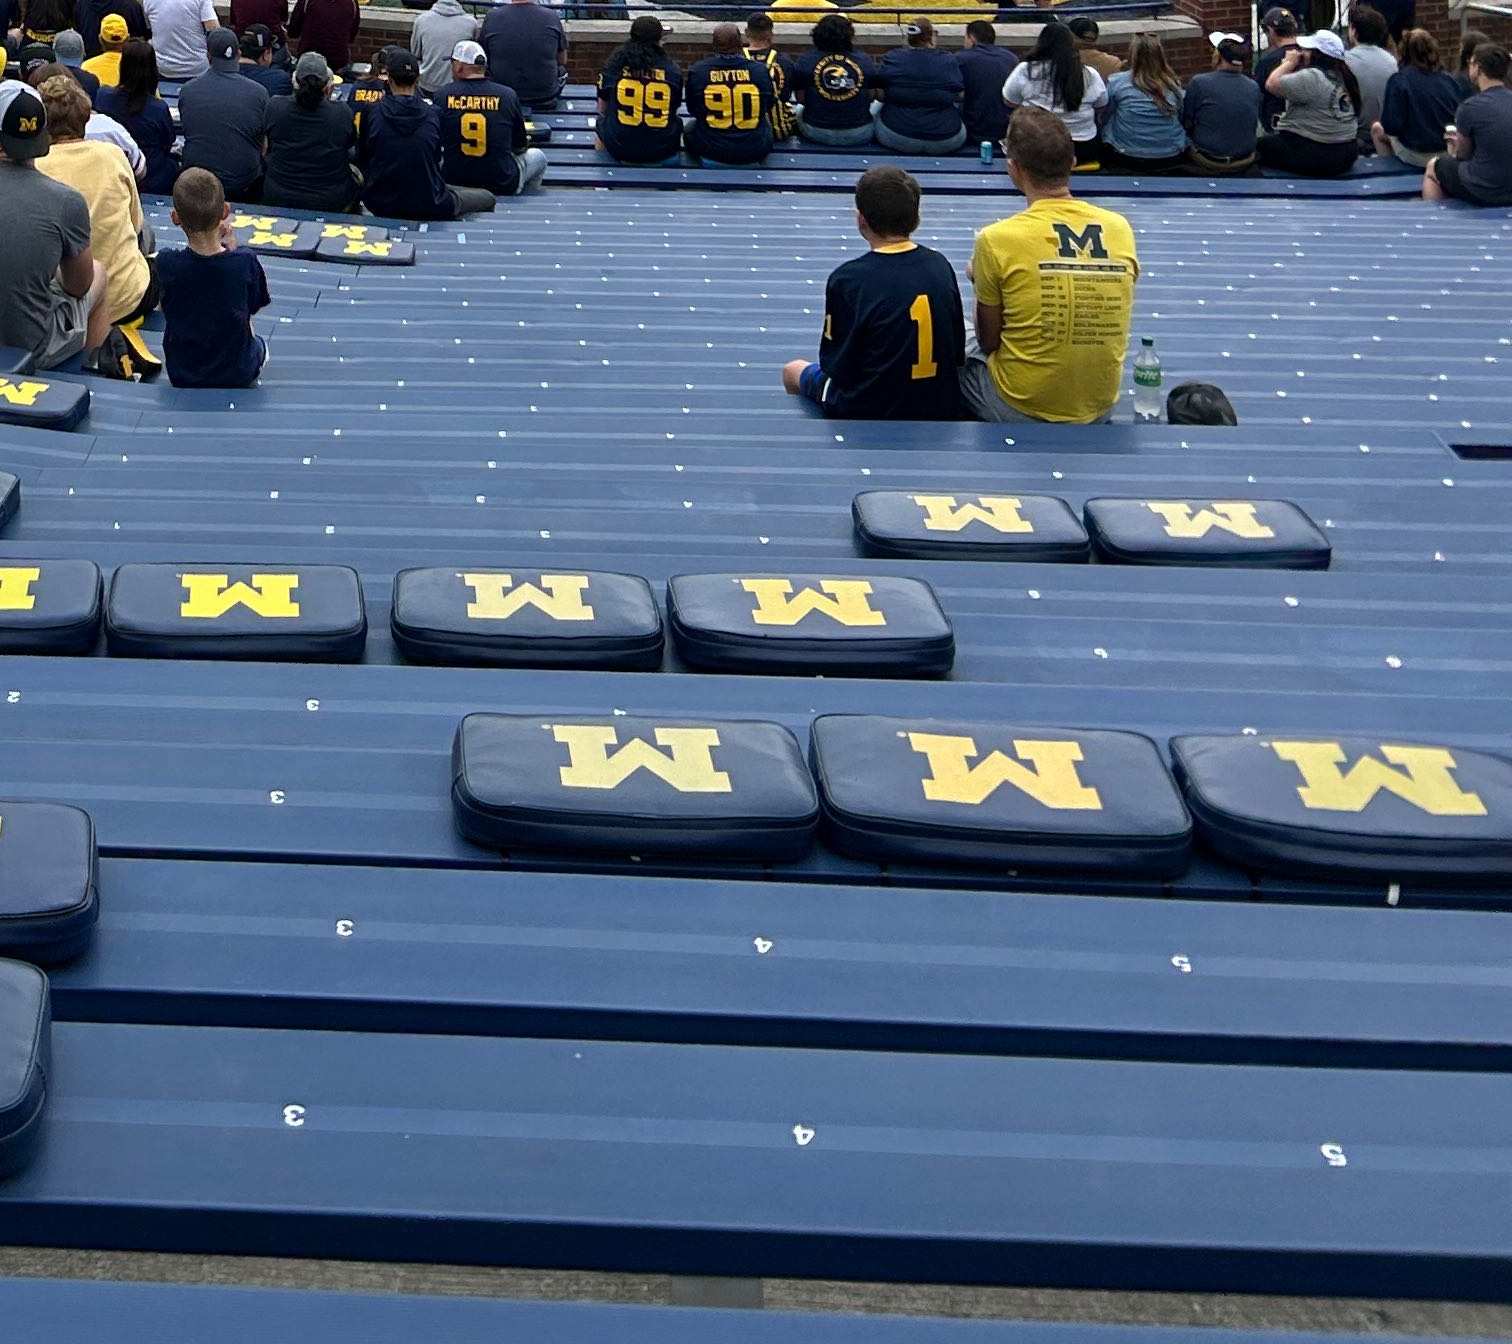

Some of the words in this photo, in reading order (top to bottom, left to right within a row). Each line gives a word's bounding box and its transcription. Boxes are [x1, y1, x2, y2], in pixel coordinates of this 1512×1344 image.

[710, 69, 750, 83] GUYTON
[447, 95, 500, 111] McCARTHY
[617, 78, 672, 129] 99
[703, 83, 761, 130] 90
[18, 116, 38, 132] M
[460, 112, 487, 158] 9
[248, 230, 298, 247] M
[344, 239, 392, 255] M
[1052, 223, 1109, 259] M
[909, 294, 938, 380] 1
[916, 496, 1032, 531] M
[1152, 503, 1271, 536] M
[181, 574, 300, 618] M
[465, 574, 593, 619] M
[743, 579, 885, 625] M
[7, 691, 21, 703] 2
[306, 699, 320, 711] 3
[553, 726, 730, 790] M
[908, 733, 1101, 809] M
[1272, 741, 1485, 815] M
[270, 790, 285, 804] 3
[336, 919, 354, 937] 3
[753, 937, 773, 954] 4
[1171, 955, 1192, 973] 5
[283, 1104, 306, 1127] 3
[792, 1124, 815, 1146] 4
[1320, 1144, 1347, 1167] 5
